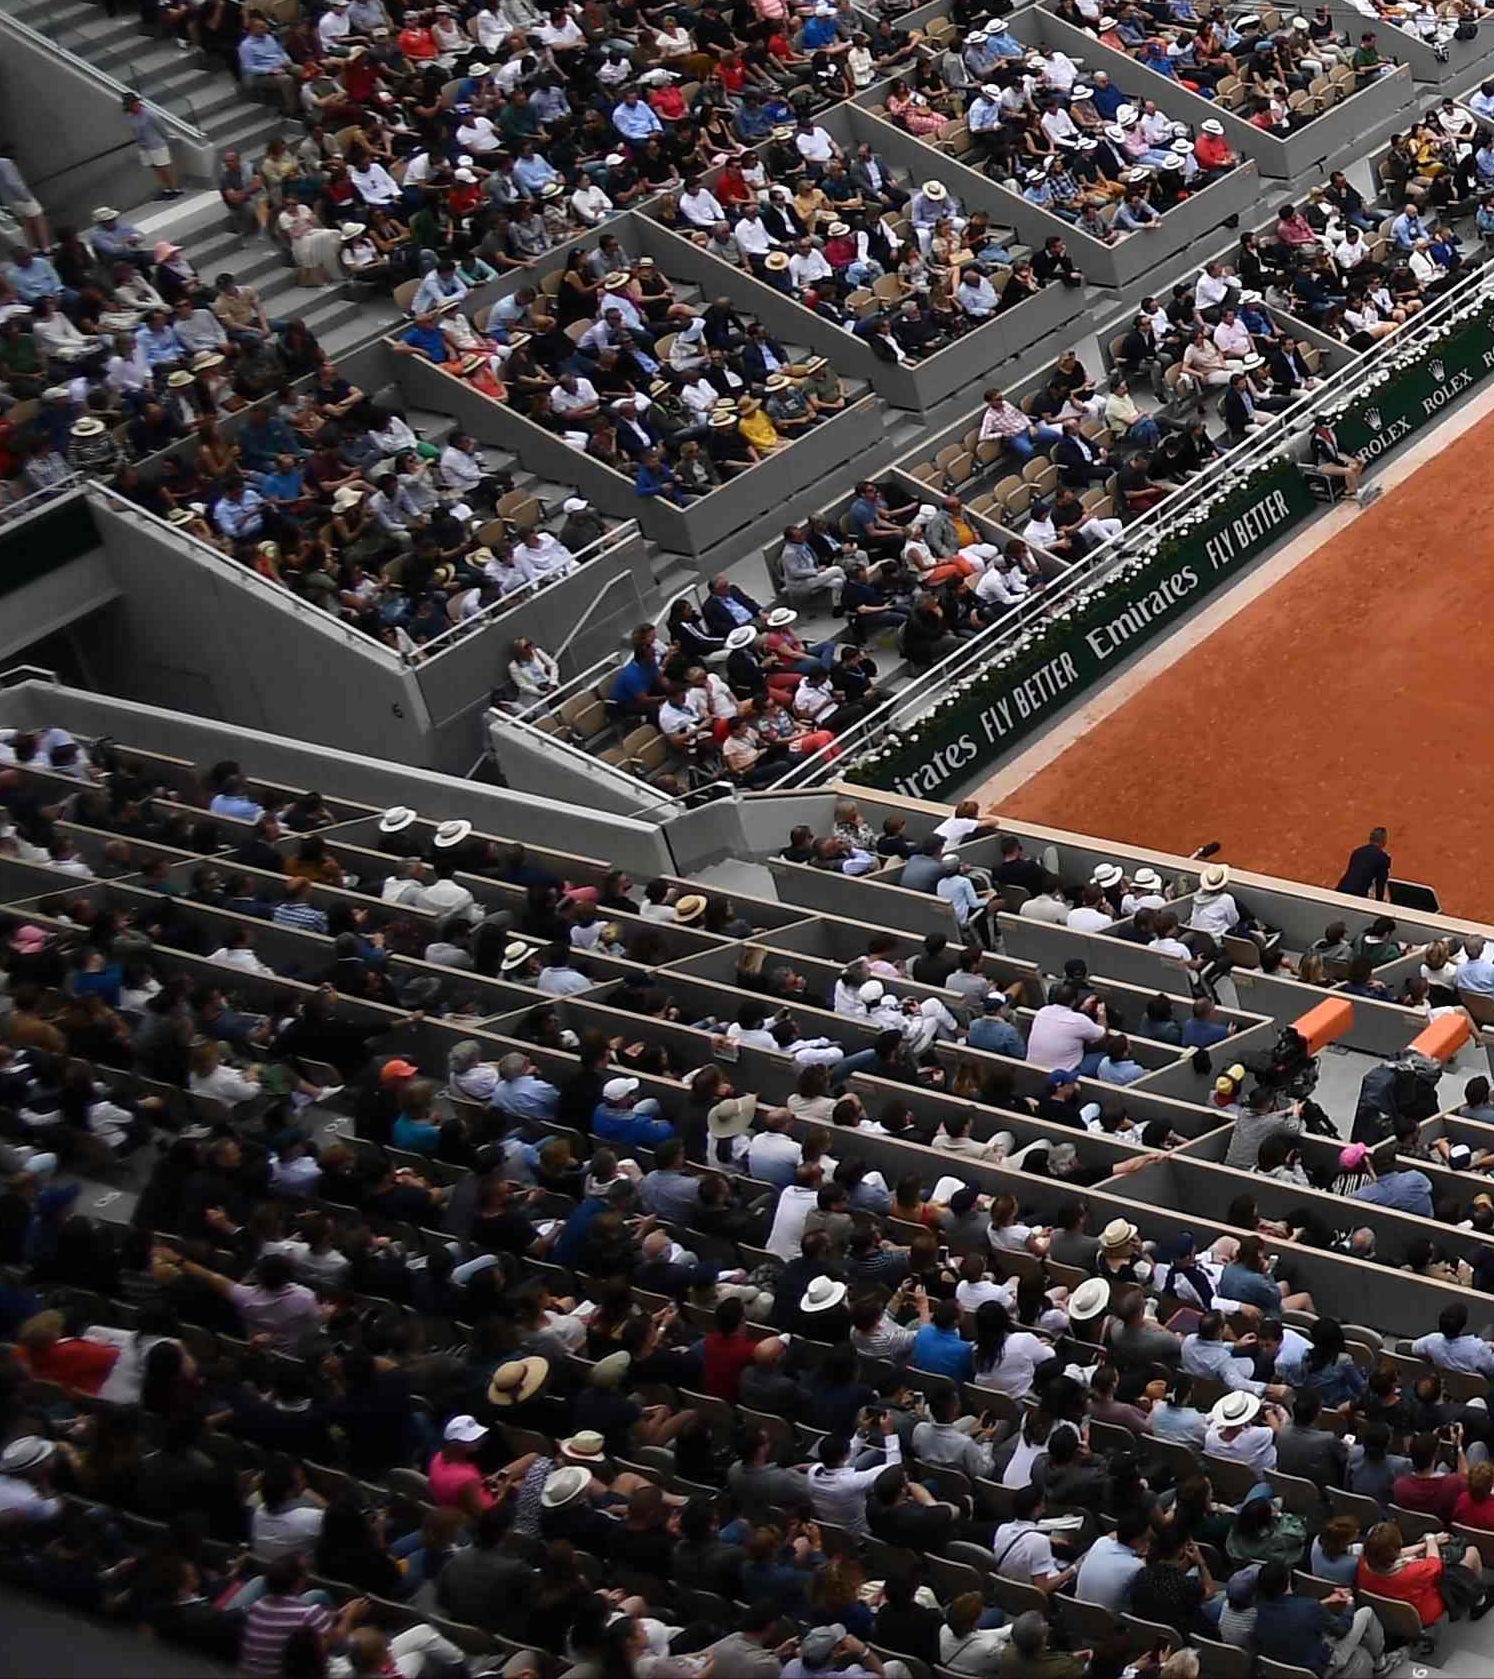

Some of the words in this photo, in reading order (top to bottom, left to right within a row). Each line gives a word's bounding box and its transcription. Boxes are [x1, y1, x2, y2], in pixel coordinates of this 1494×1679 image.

[1359, 416, 1412, 464] ROLEX
[1421, 368, 1474, 414] ROLEX
[1086, 565, 1198, 660] Emirates
[1205, 528, 1236, 570] FLY
[1233, 489, 1290, 549] BETTER
[894, 733, 978, 800] irates
[980, 697, 1014, 744] FLY
[1013, 651, 1079, 719] BETTER
